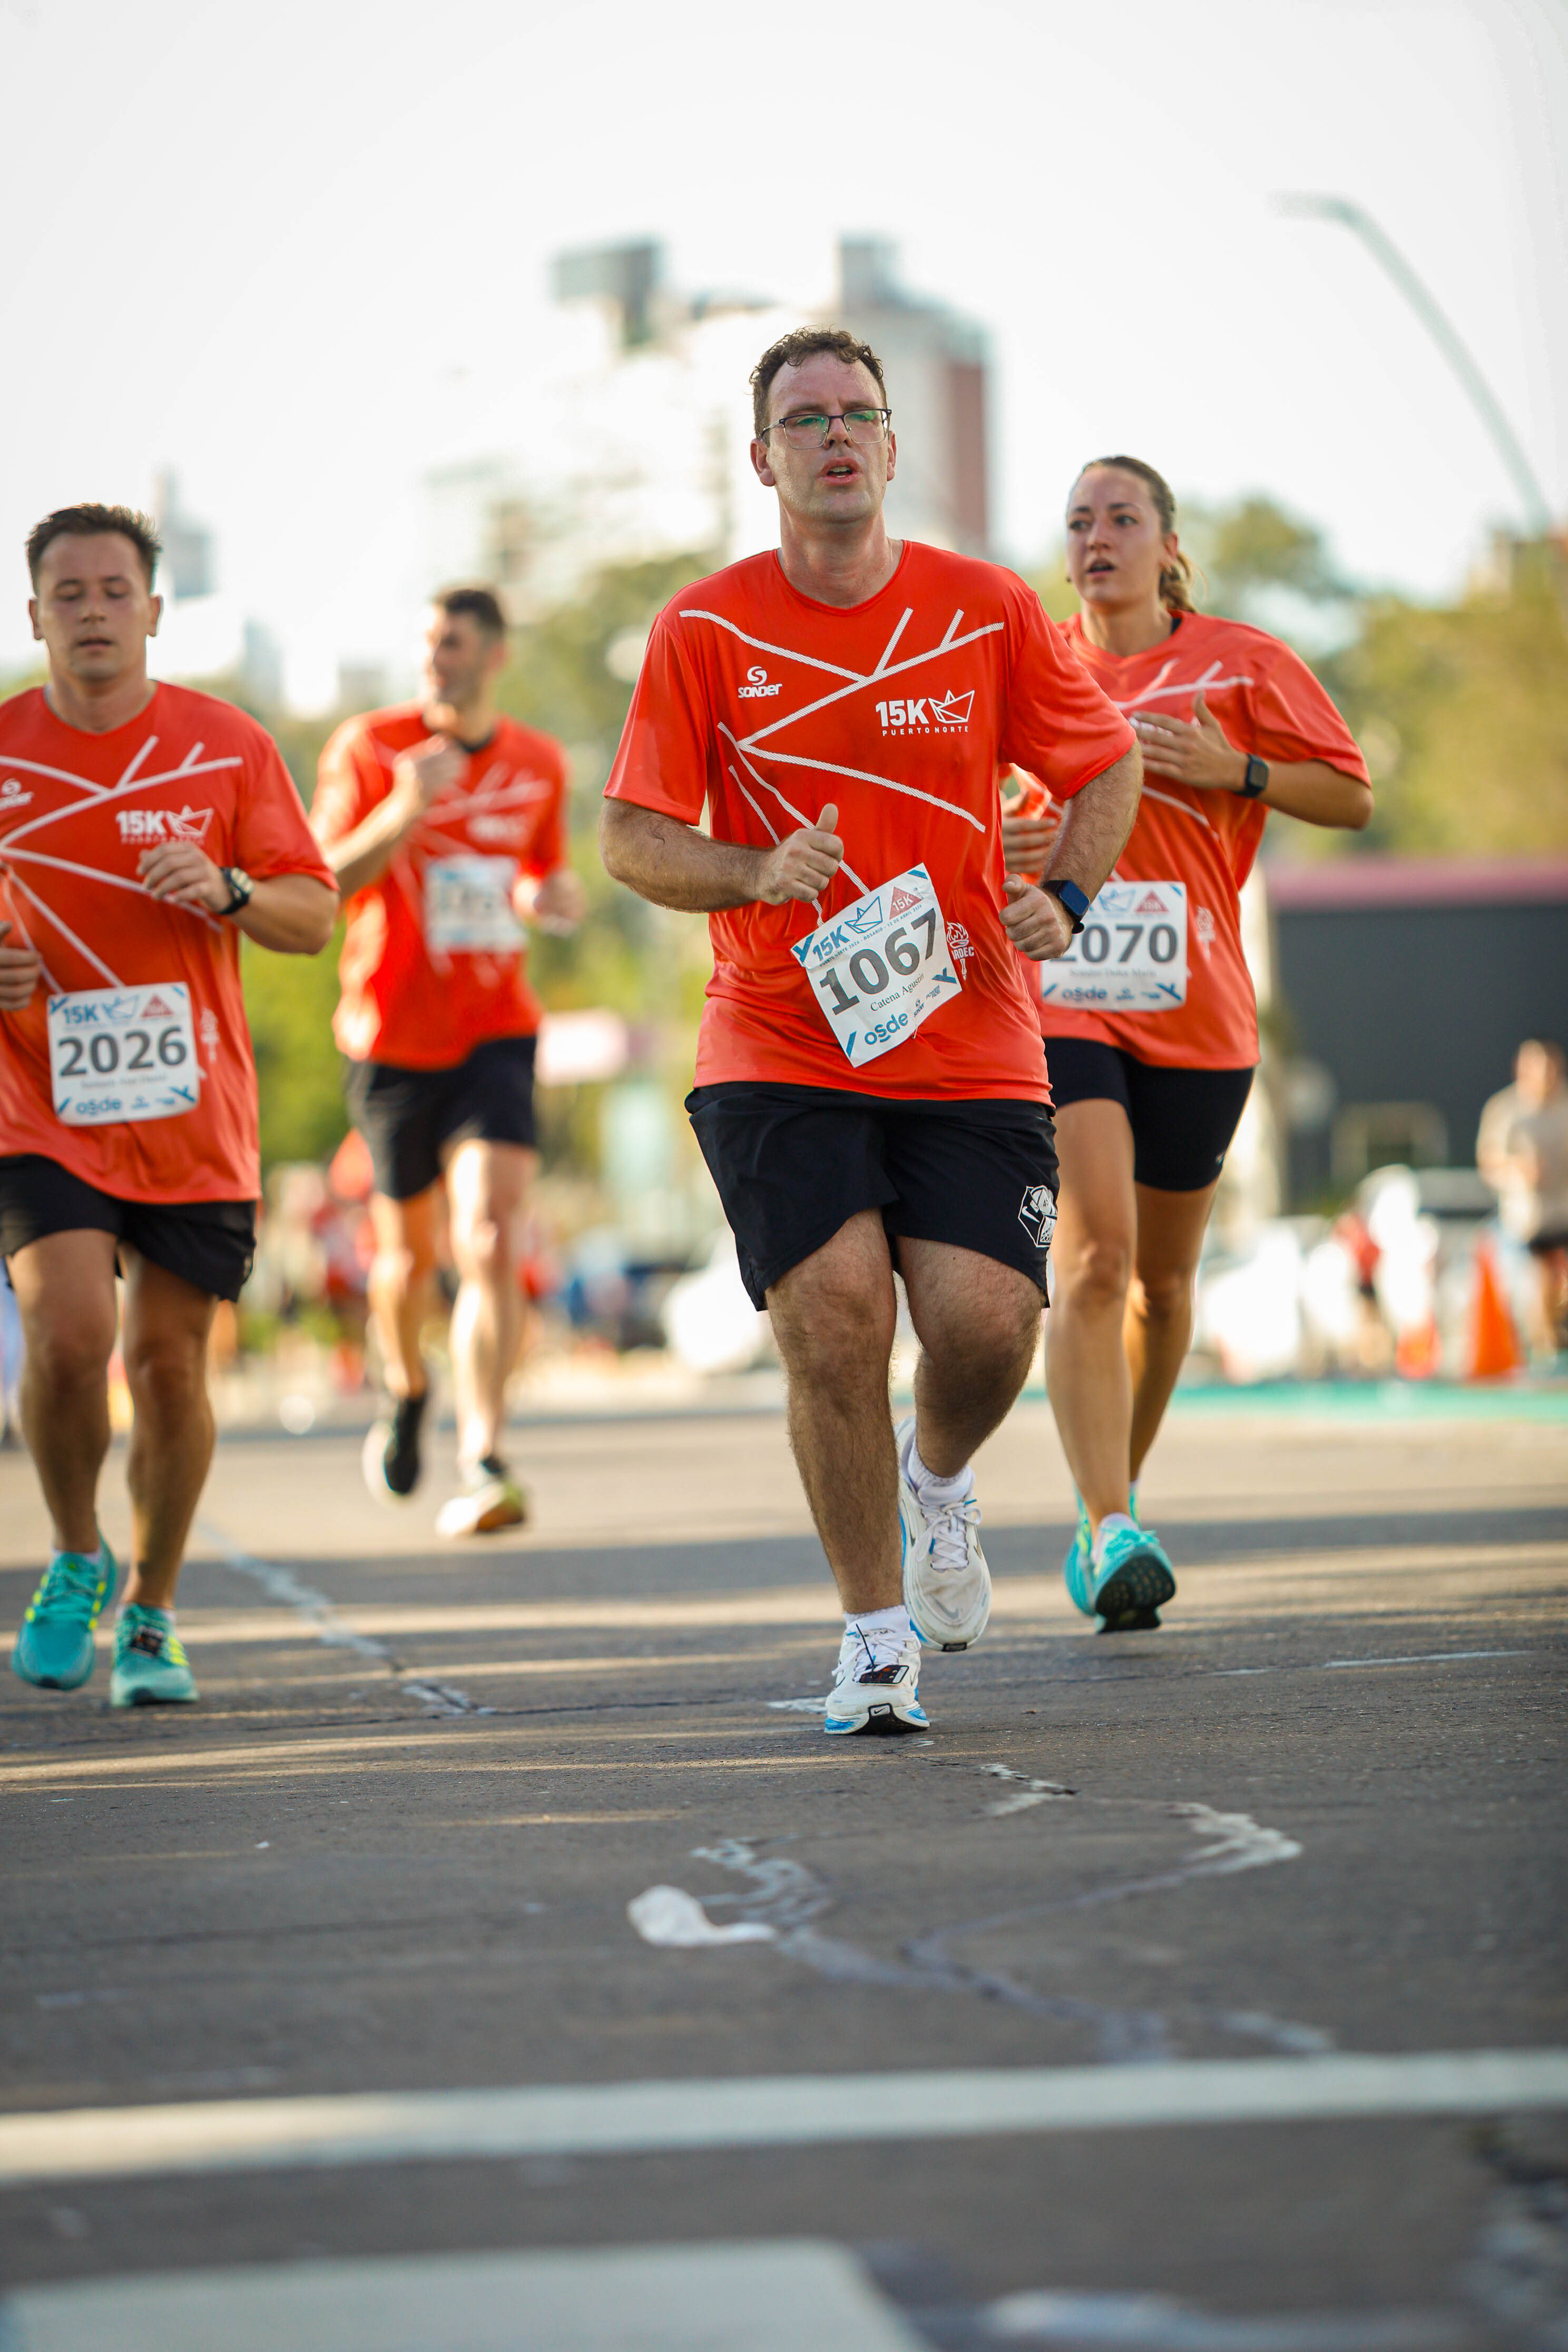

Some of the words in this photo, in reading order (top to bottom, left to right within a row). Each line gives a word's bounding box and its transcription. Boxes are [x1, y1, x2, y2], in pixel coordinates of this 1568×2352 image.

[875, 699, 929, 727] 15K
[882, 727, 930, 737] PUERTO
[115, 810, 167, 835] 15K
[893, 894, 914, 911] 15K
[813, 925, 850, 962] 15K
[834, 947, 848, 958] NORTE
[864, 927, 883, 940] ROSARIO
[900, 910, 913, 920] ABRIL
[819, 907, 937, 1016] 1067
[870, 992, 900, 1012] Catena
[1063, 985, 1108, 1002] osde
[63, 1003, 99, 1024] 15K
[864, 1013, 908, 1045] osde
[57, 1026, 188, 1077] 2026
